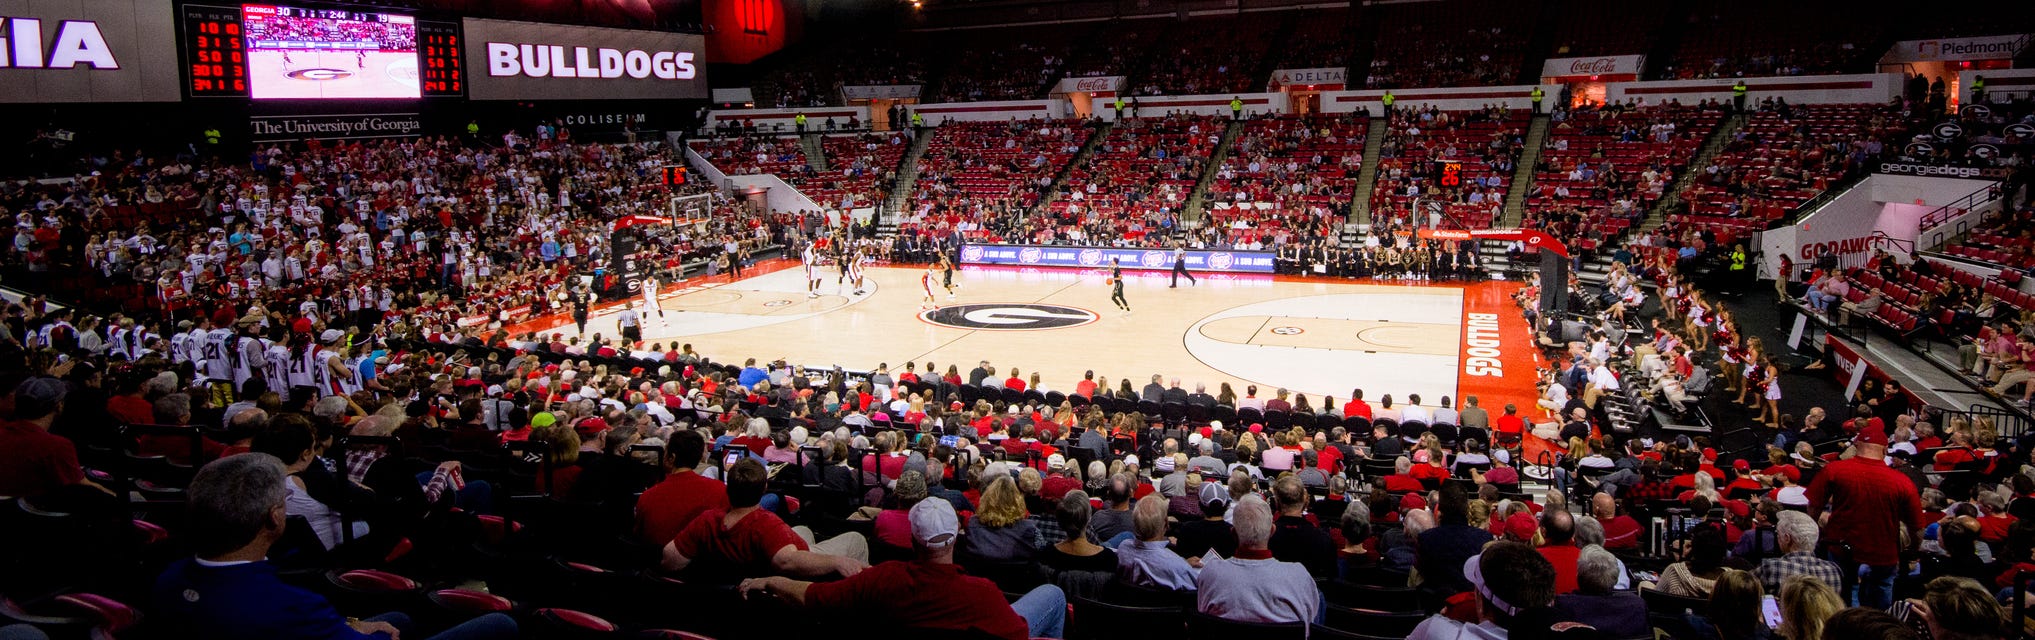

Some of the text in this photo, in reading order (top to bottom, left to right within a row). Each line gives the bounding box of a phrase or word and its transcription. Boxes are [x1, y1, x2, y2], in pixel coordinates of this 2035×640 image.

[245, 6, 275, 14] GEORGIA
[276, 6, 291, 16] 30
[329, 10, 346, 19] 2:44
[377, 14, 388, 22] 19
[0, 16, 121, 70] IA
[197, 35, 208, 48] 3
[230, 37, 240, 49] 5
[449, 35, 456, 45] 2
[427, 46, 435, 56] 3
[450, 47, 457, 57] 3
[1942, 41, 2013, 54] Piedmont
[198, 50, 241, 63] 5 0 0
[487, 42, 697, 80] BULLDOGS
[428, 58, 459, 68] 5 0 7
[212, 65, 223, 76] 0
[233, 65, 243, 77] 3
[452, 70, 459, 80] 2
[1295, 72, 1341, 82] DELTA
[218, 79, 225, 90] 1
[233, 79, 245, 91] 6
[453, 81, 460, 91] 2
[250, 117, 420, 135] The University of Georgia
[1881, 163, 2007, 178] georgiadogs.co
[1441, 171, 1459, 186] 26
[1047, 252, 1059, 260] SUB
[1234, 257, 1239, 265] A
[206, 342, 219, 359] 21
[1466, 312, 1503, 378] BULLDOGS
[267, 361, 277, 379] 21
